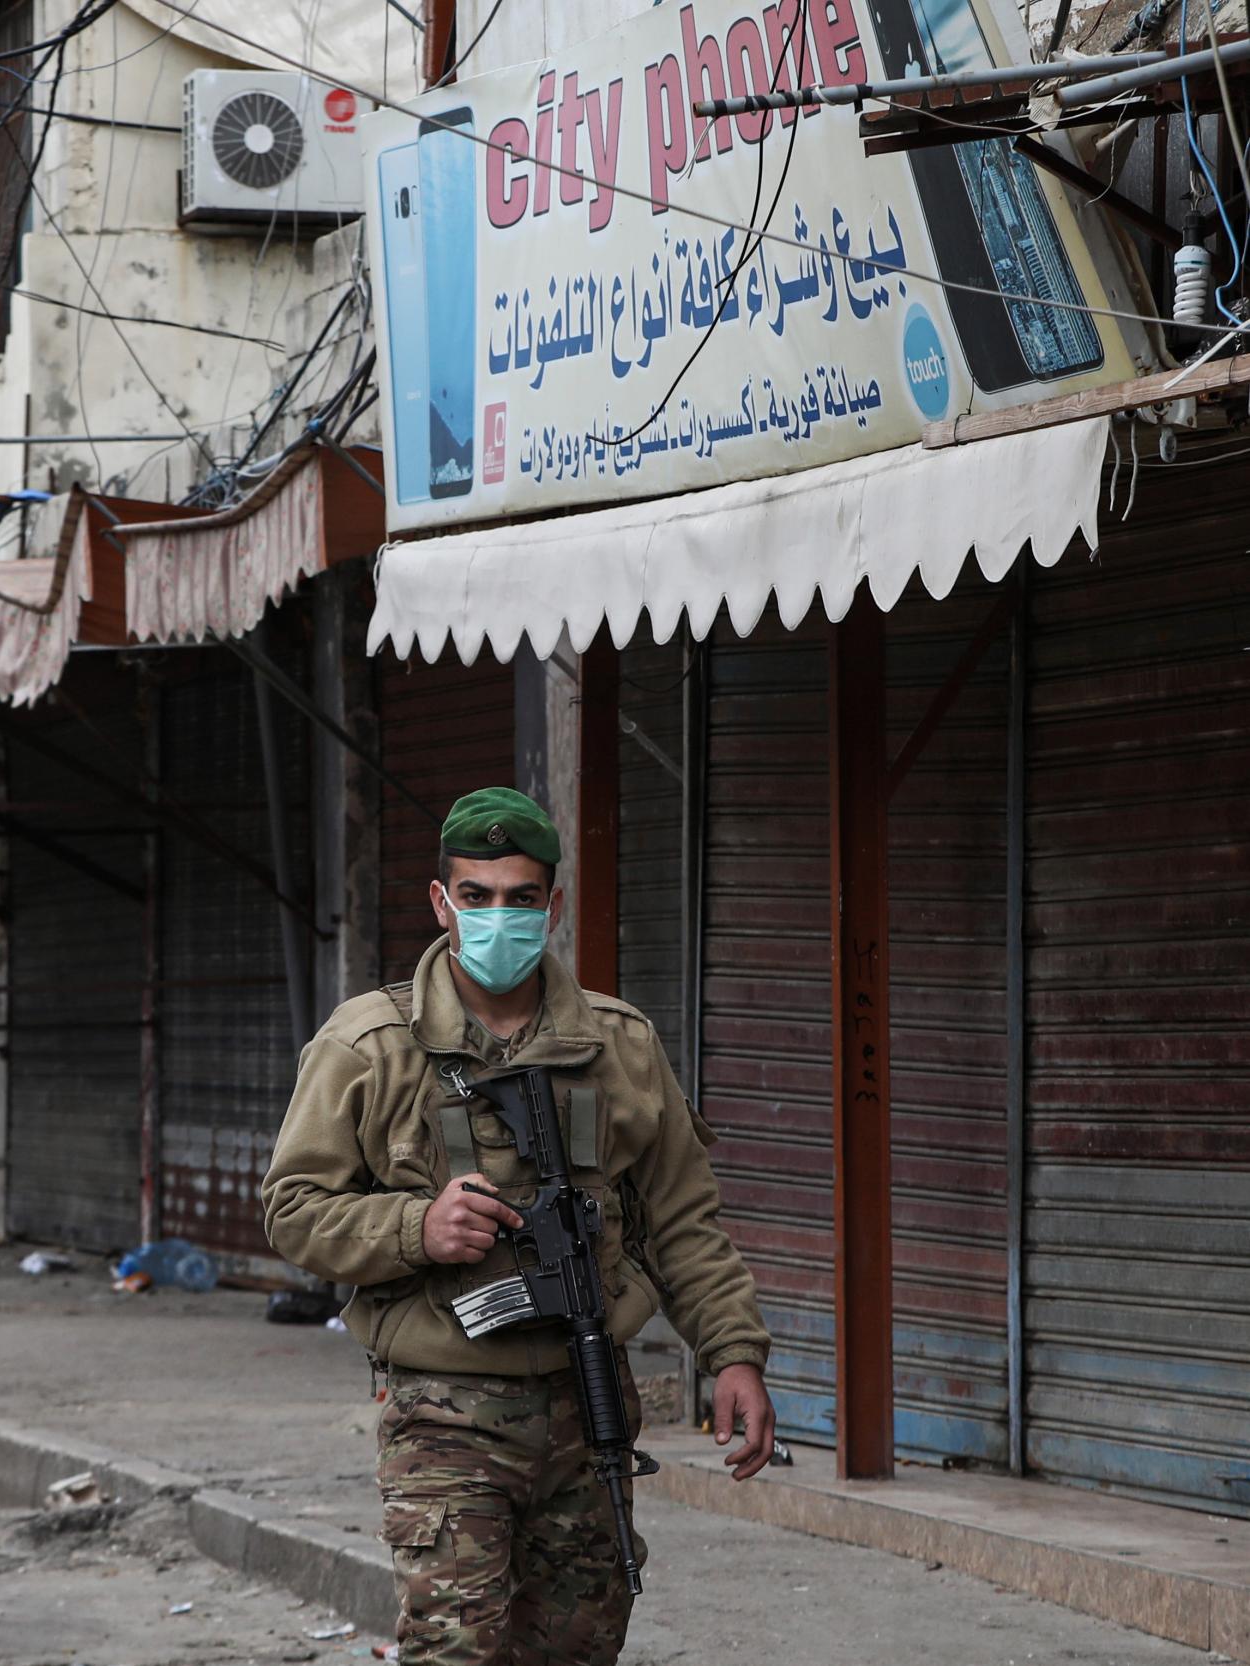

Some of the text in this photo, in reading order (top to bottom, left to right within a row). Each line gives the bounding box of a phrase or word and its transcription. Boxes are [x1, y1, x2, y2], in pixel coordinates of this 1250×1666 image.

[486, 0, 867, 233] city phone
[489, 203, 907, 390] بيع وشراء كافة أنواع التلفونات
[817, 365, 881, 428] صيانة
[907, 347, 945, 384] touch
[583, 403, 610, 480] أيام
[764, 372, 821, 442] فورية
[520, 424, 580, 483] ودولارات
